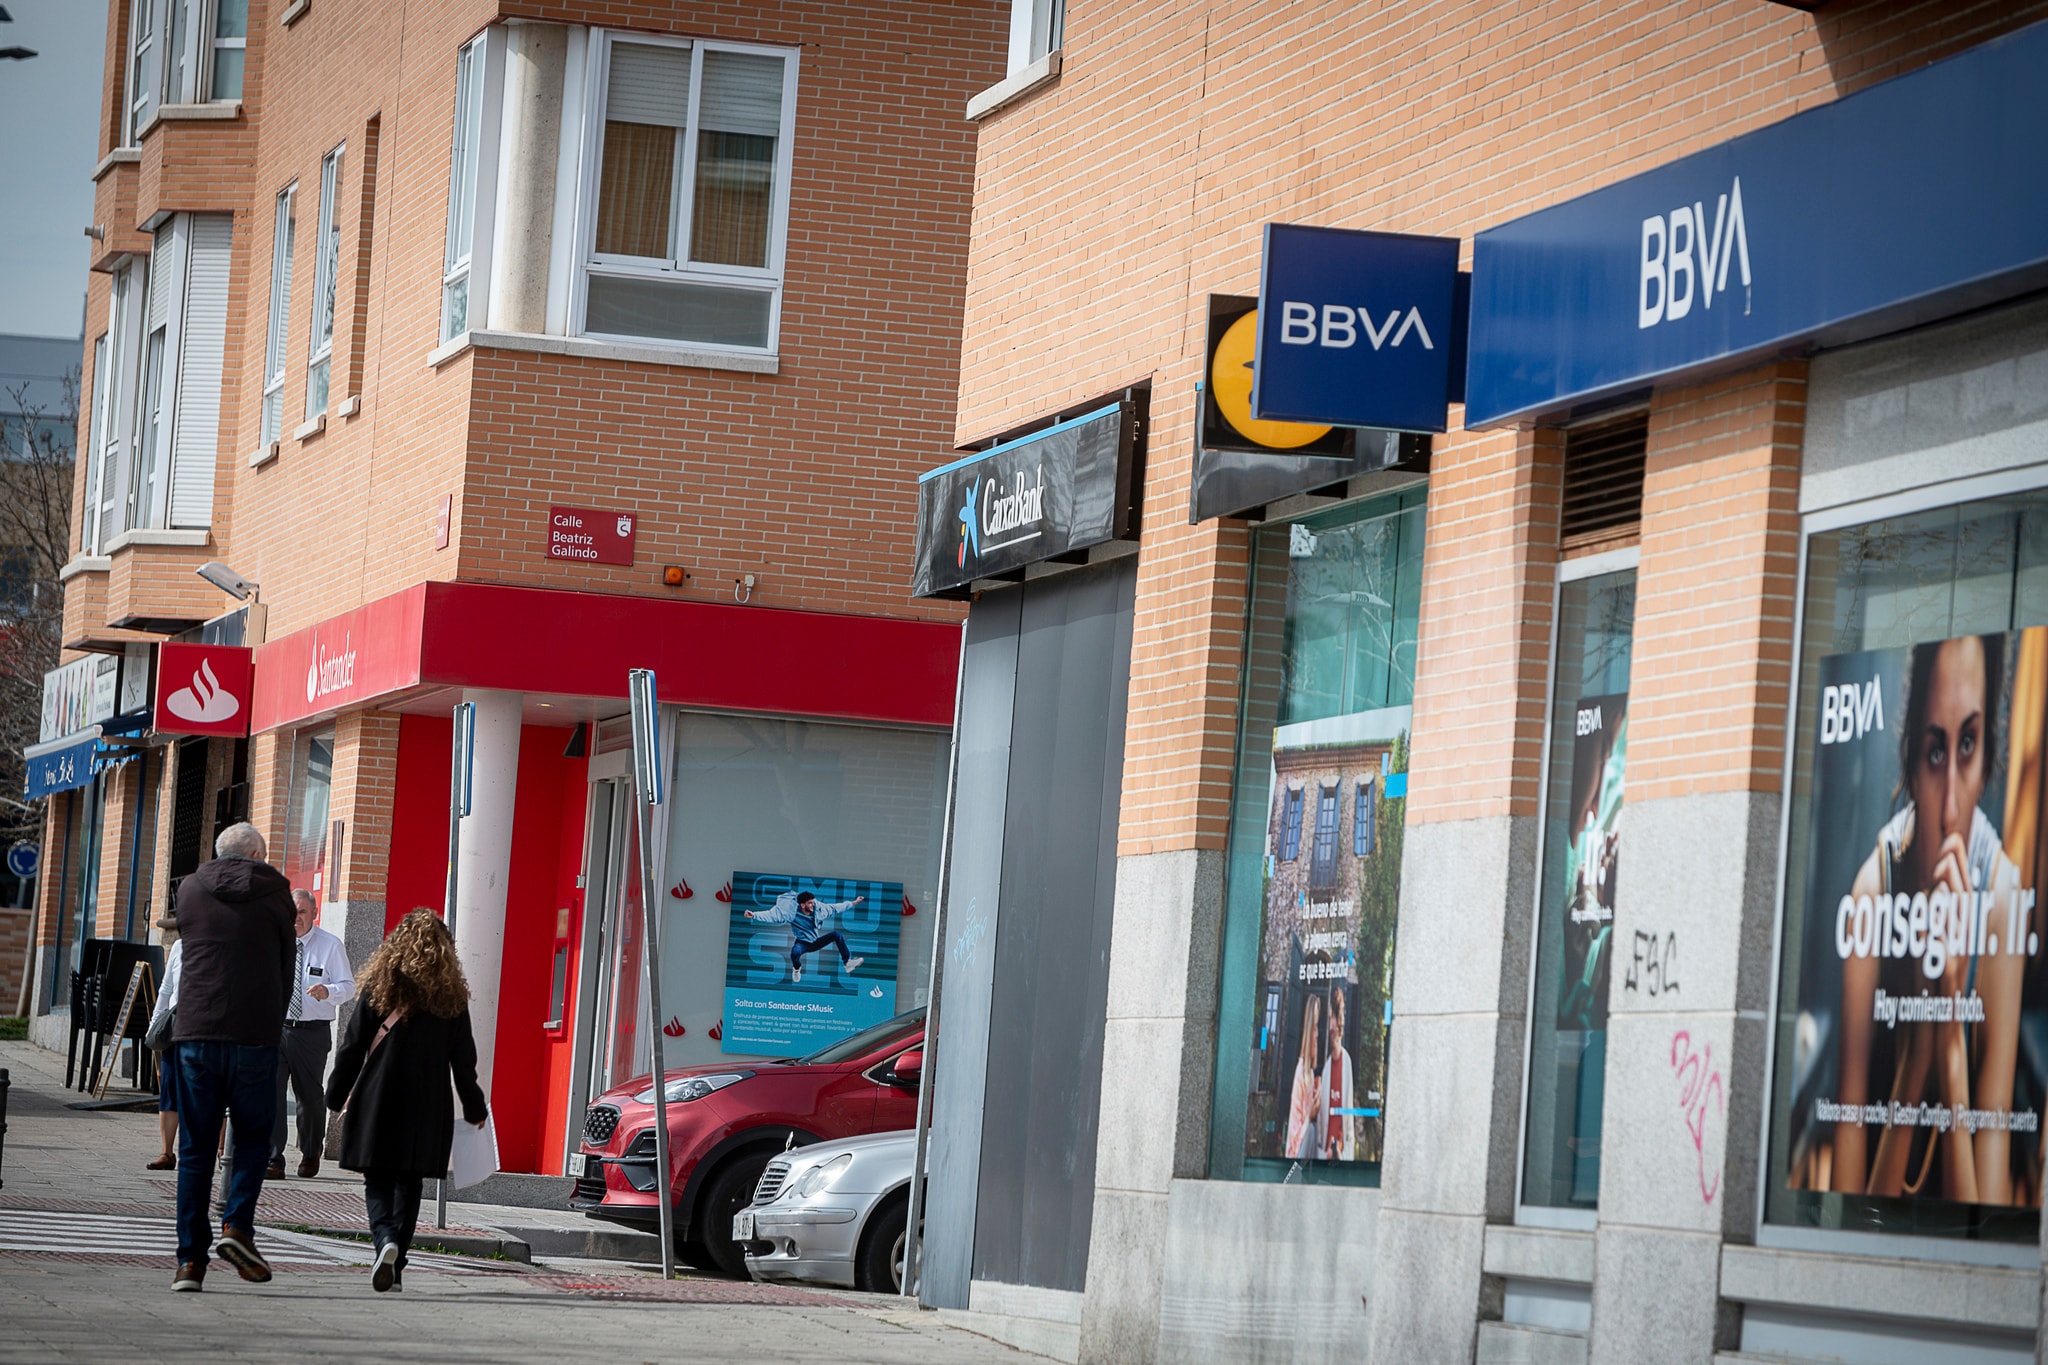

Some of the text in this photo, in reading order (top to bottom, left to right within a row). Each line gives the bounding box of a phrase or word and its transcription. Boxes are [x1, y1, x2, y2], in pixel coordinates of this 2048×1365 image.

[1638, 175, 1752, 330] BBVA
[1280, 301, 1434, 351] BBVA
[982, 463, 1044, 537] CaixaBank
[552, 531, 593, 546] Beatriz
[553, 514, 583, 528] Calle
[551, 544, 599, 559] Galindo
[316, 629, 357, 698] Santander
[1575, 704, 1603, 737] BBVA
[1820, 673, 1884, 745] BBVA
[1310, 897, 1328, 919] bueno
[1329, 896, 1338, 917] de
[1835, 864, 2039, 980] conseguir. ir.
[1306, 963, 1318, 984] que
[1318, 960, 1325, 979] te
[734, 999, 834, 1013] Salta con Santander SMusic
[1873, 988, 1899, 1030] Hoy
[1898, 989, 1954, 1022] comienza
